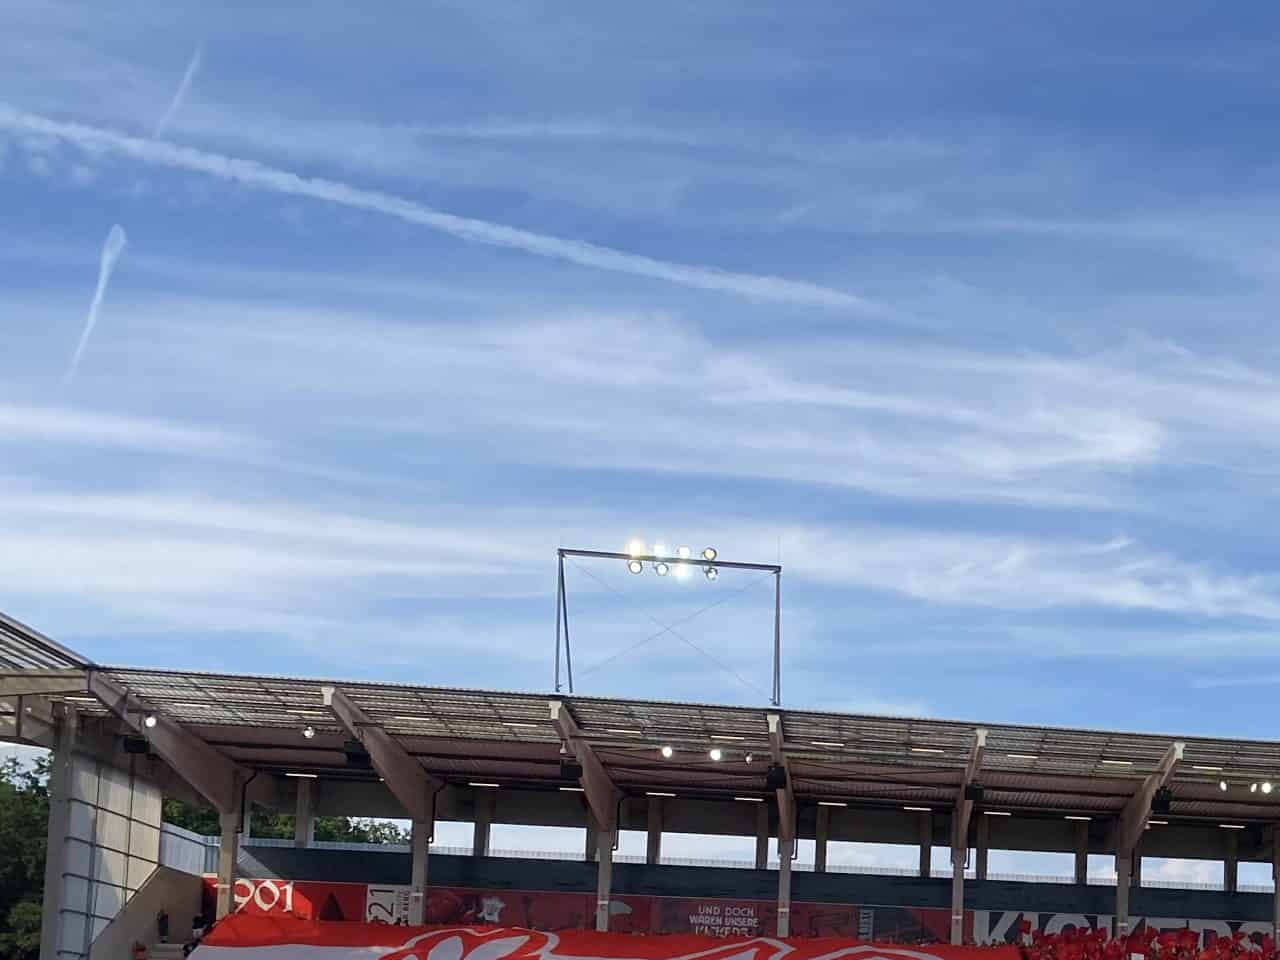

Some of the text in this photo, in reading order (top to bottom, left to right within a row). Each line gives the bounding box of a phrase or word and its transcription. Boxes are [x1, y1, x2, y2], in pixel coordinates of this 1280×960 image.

[211, 879, 294, 913] 901
[698, 904, 754, 917] UND DOCH
